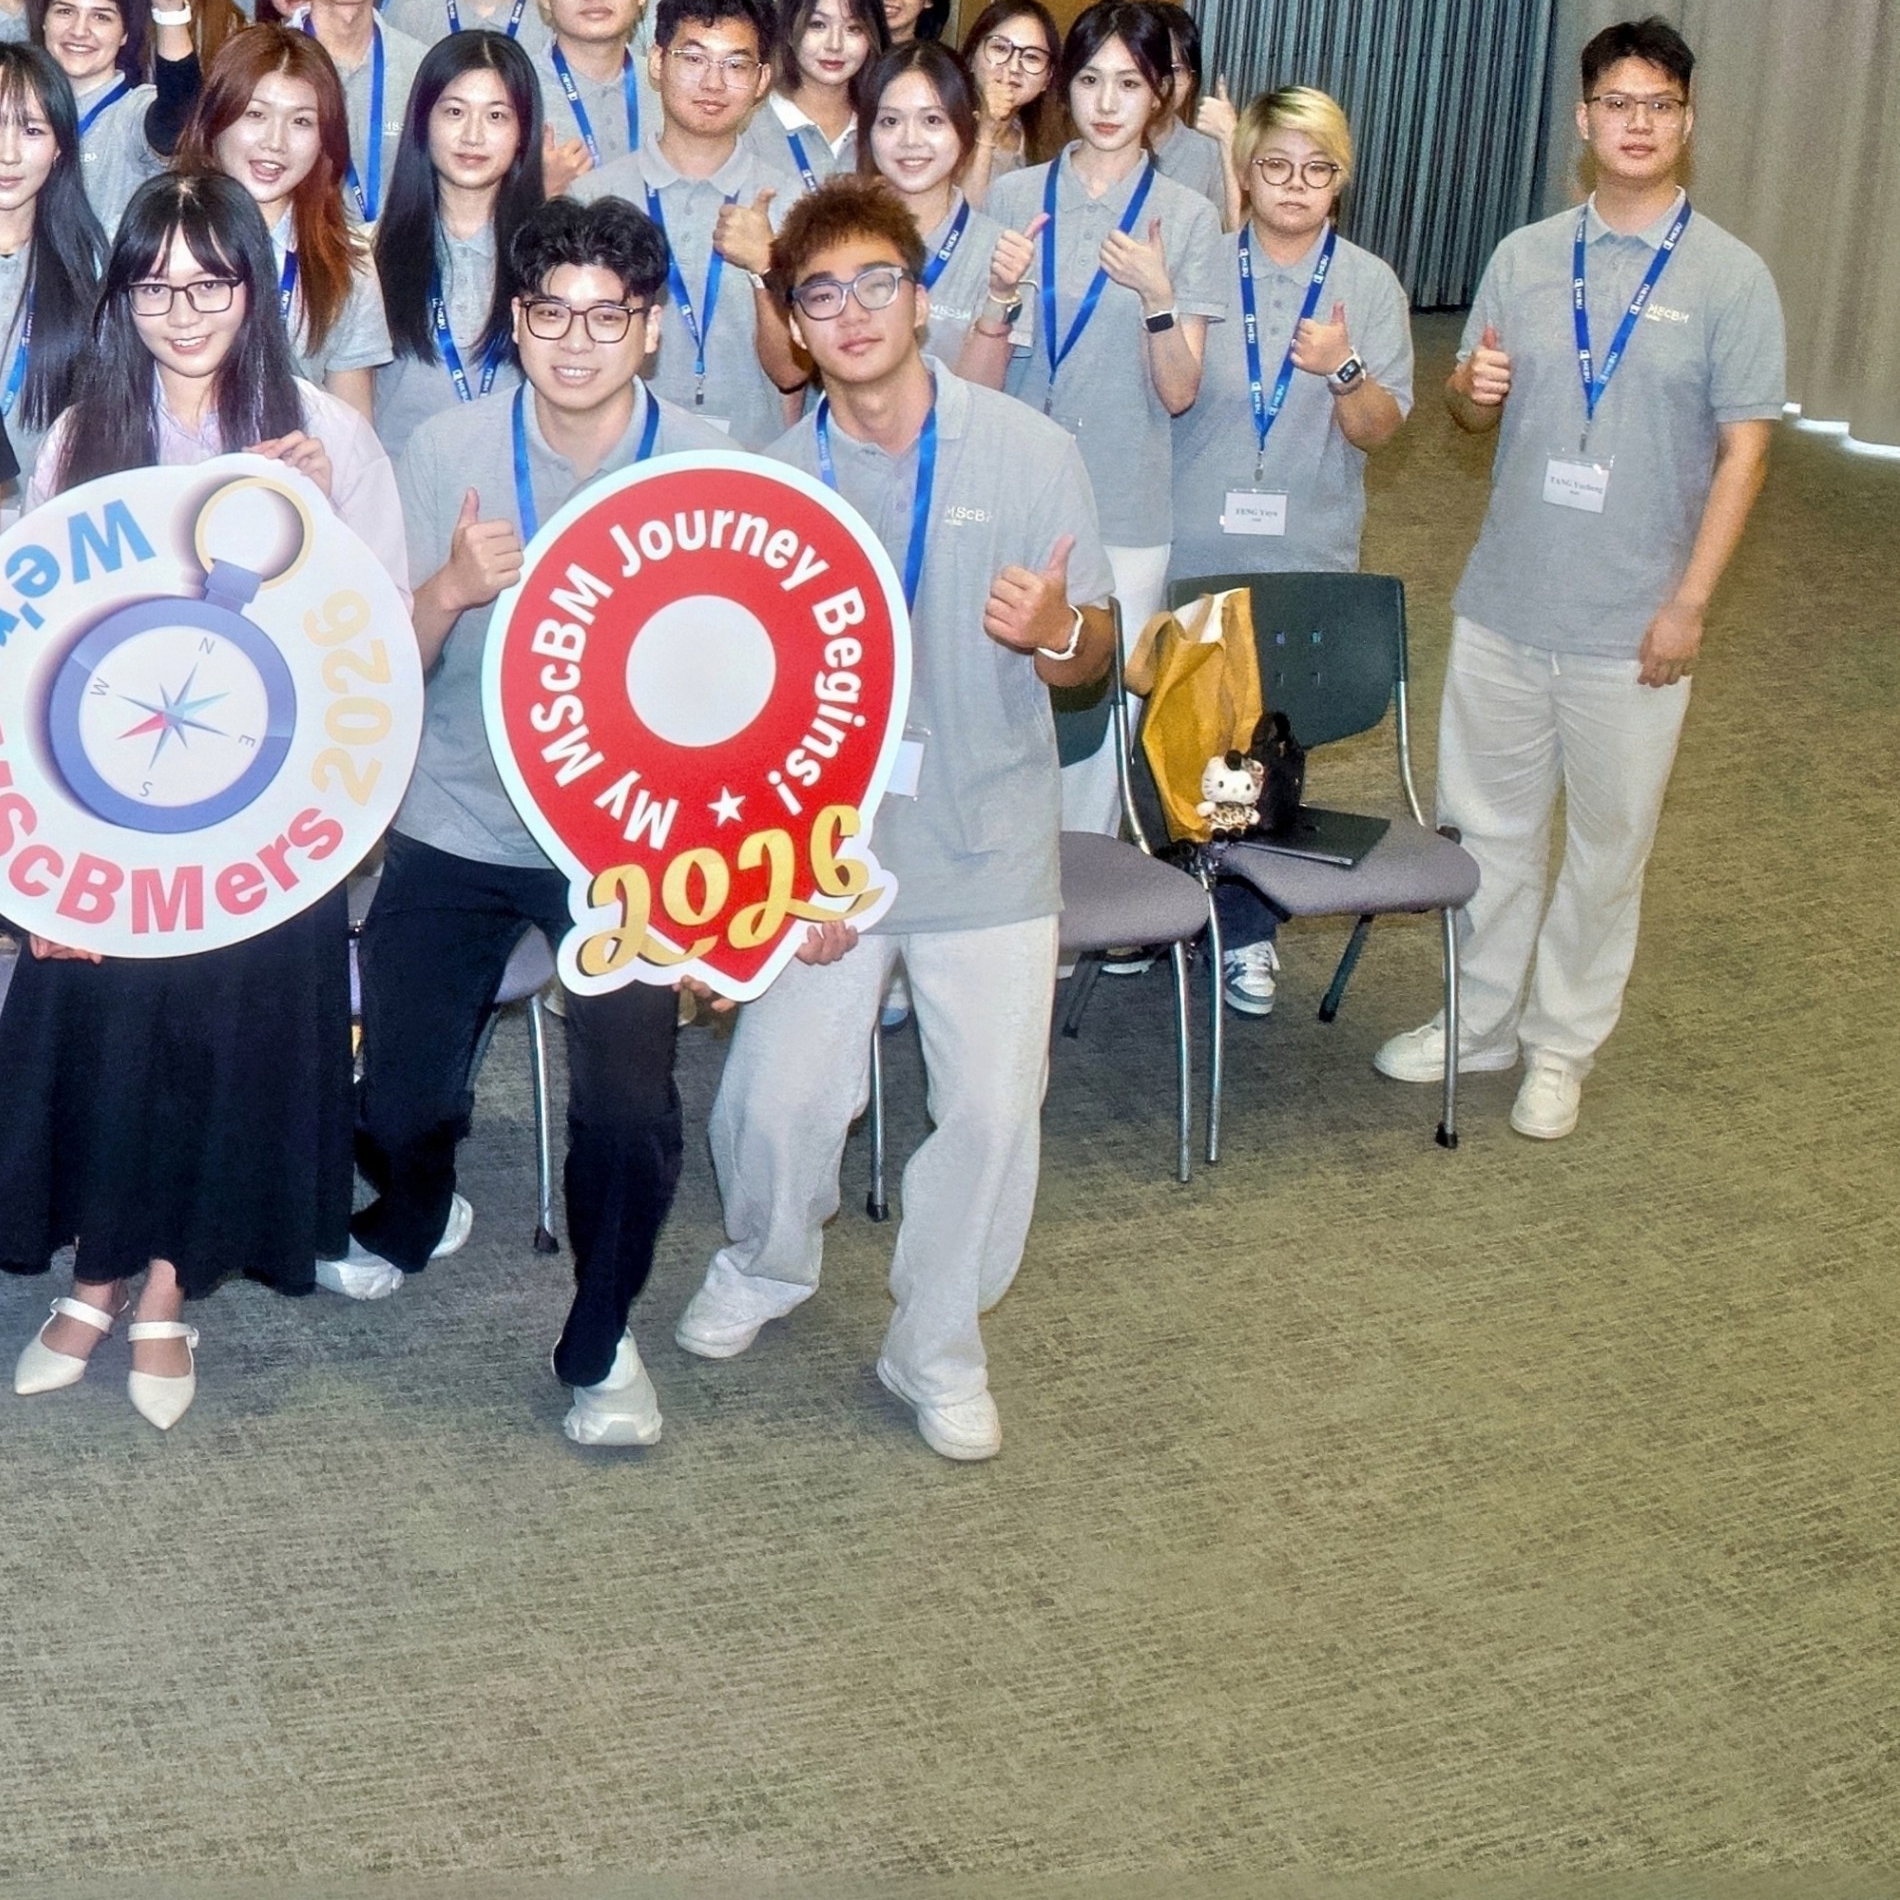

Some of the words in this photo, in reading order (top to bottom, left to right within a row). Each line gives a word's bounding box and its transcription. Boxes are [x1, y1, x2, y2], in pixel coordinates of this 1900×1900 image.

[1669, 221, 1682, 243] HKBU
[1247, 324, 1255, 344] HKBU
[1576, 286, 1584, 309] HKBU
[1636, 284, 1650, 306] HKBU
[1583, 359, 1591, 383] HKBU
[608, 508, 830, 592] Journey
[302, 589, 393, 806] 2026
[530, 562, 614, 788] MScBM
[767, 586, 867, 816] Begins!
[593, 771, 679, 851] My
[576, 805, 886, 977] 2026
